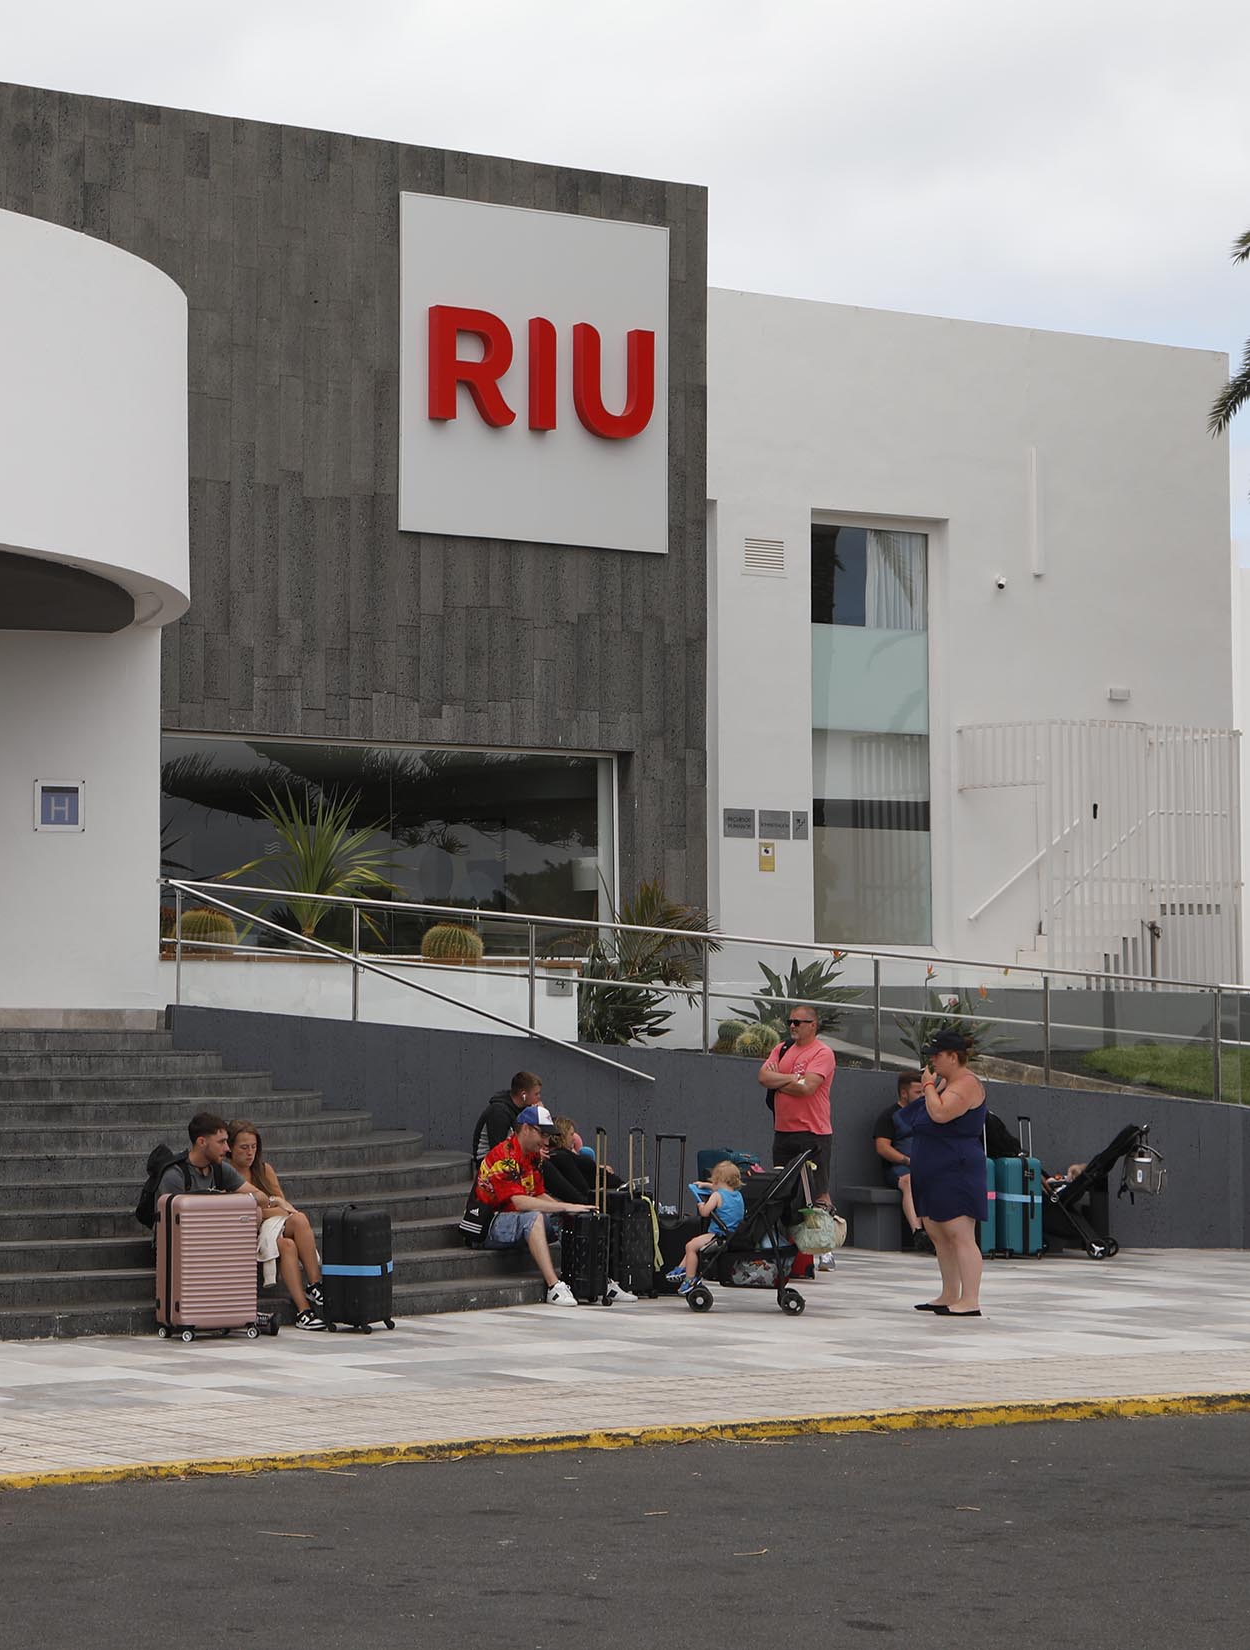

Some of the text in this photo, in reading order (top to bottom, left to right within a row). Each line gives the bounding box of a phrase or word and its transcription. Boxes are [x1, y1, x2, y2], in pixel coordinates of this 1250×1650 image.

[428, 304, 655, 440] RIU
[50, 797, 69, 821] H
[555, 977, 566, 989] 4
